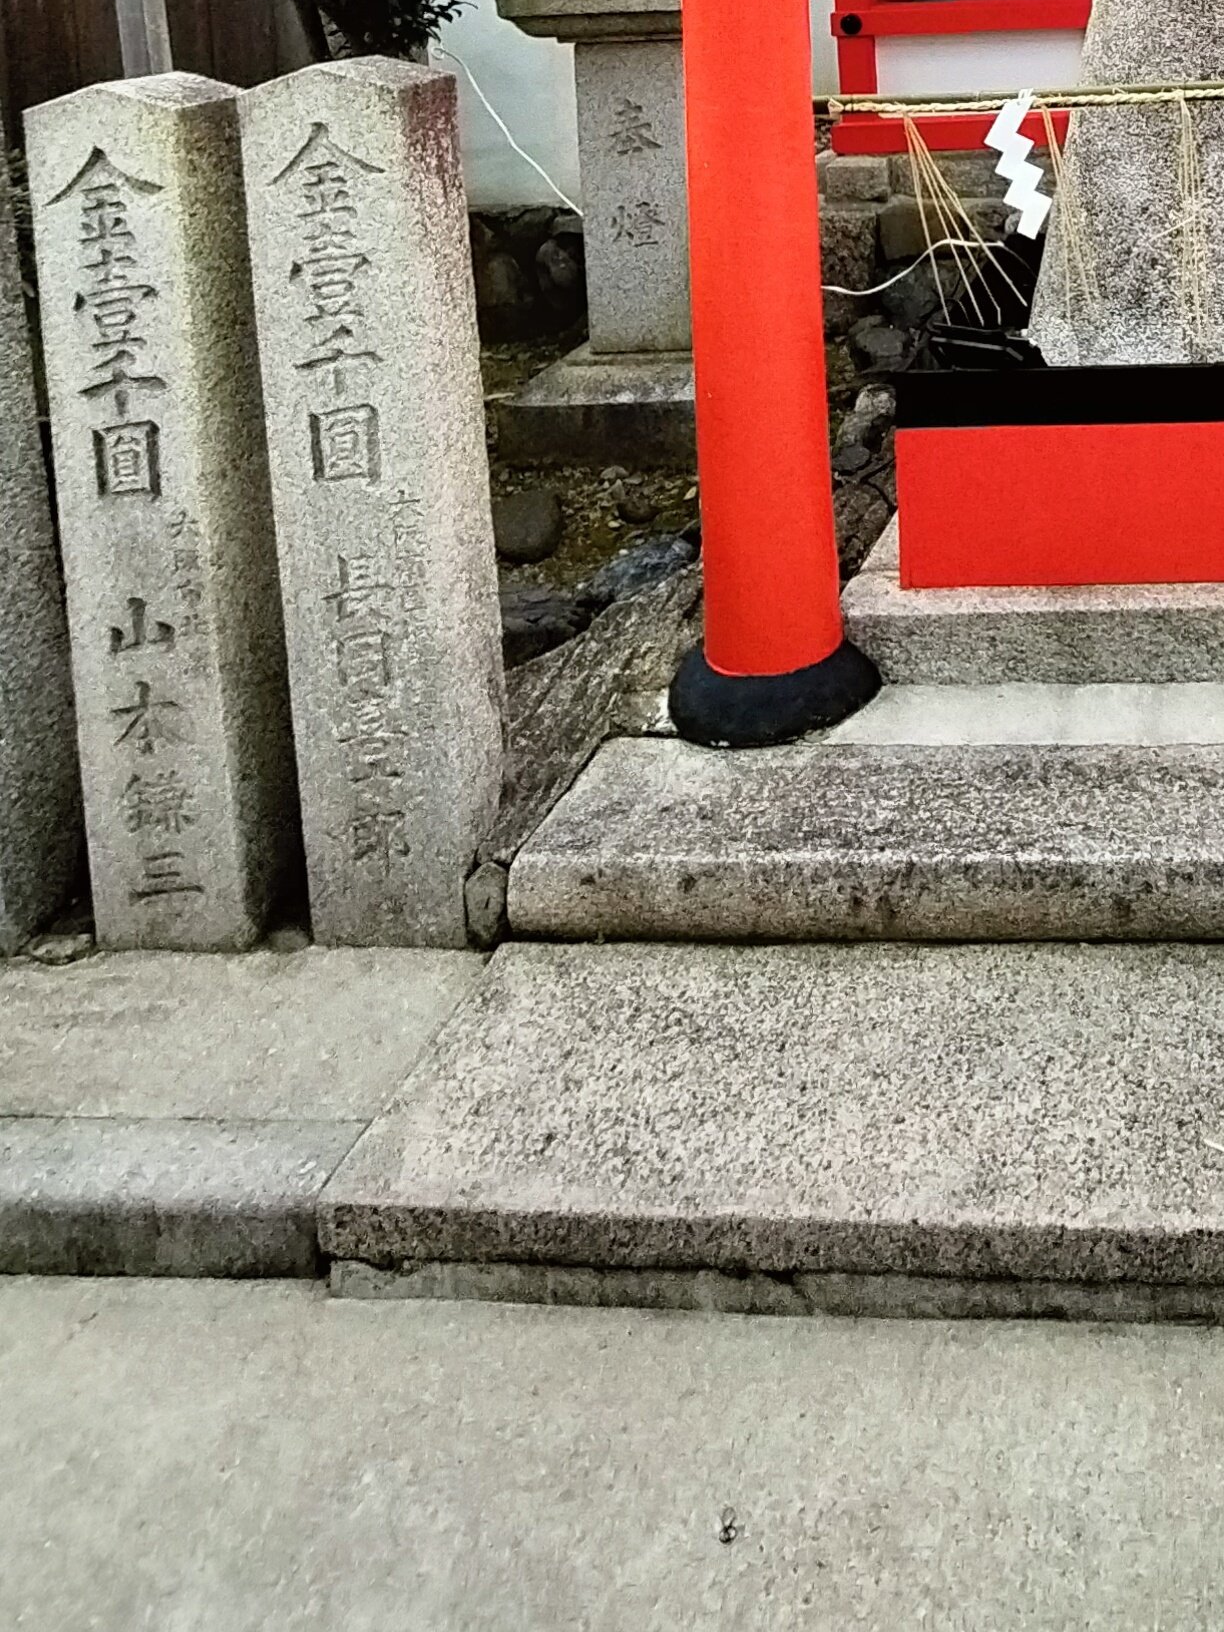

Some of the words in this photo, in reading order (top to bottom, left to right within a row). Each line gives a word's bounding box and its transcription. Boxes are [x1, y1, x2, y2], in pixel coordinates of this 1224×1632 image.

[42, 145, 166, 498] 金壹千圓
[265, 121, 388, 486] 金壹千圓
